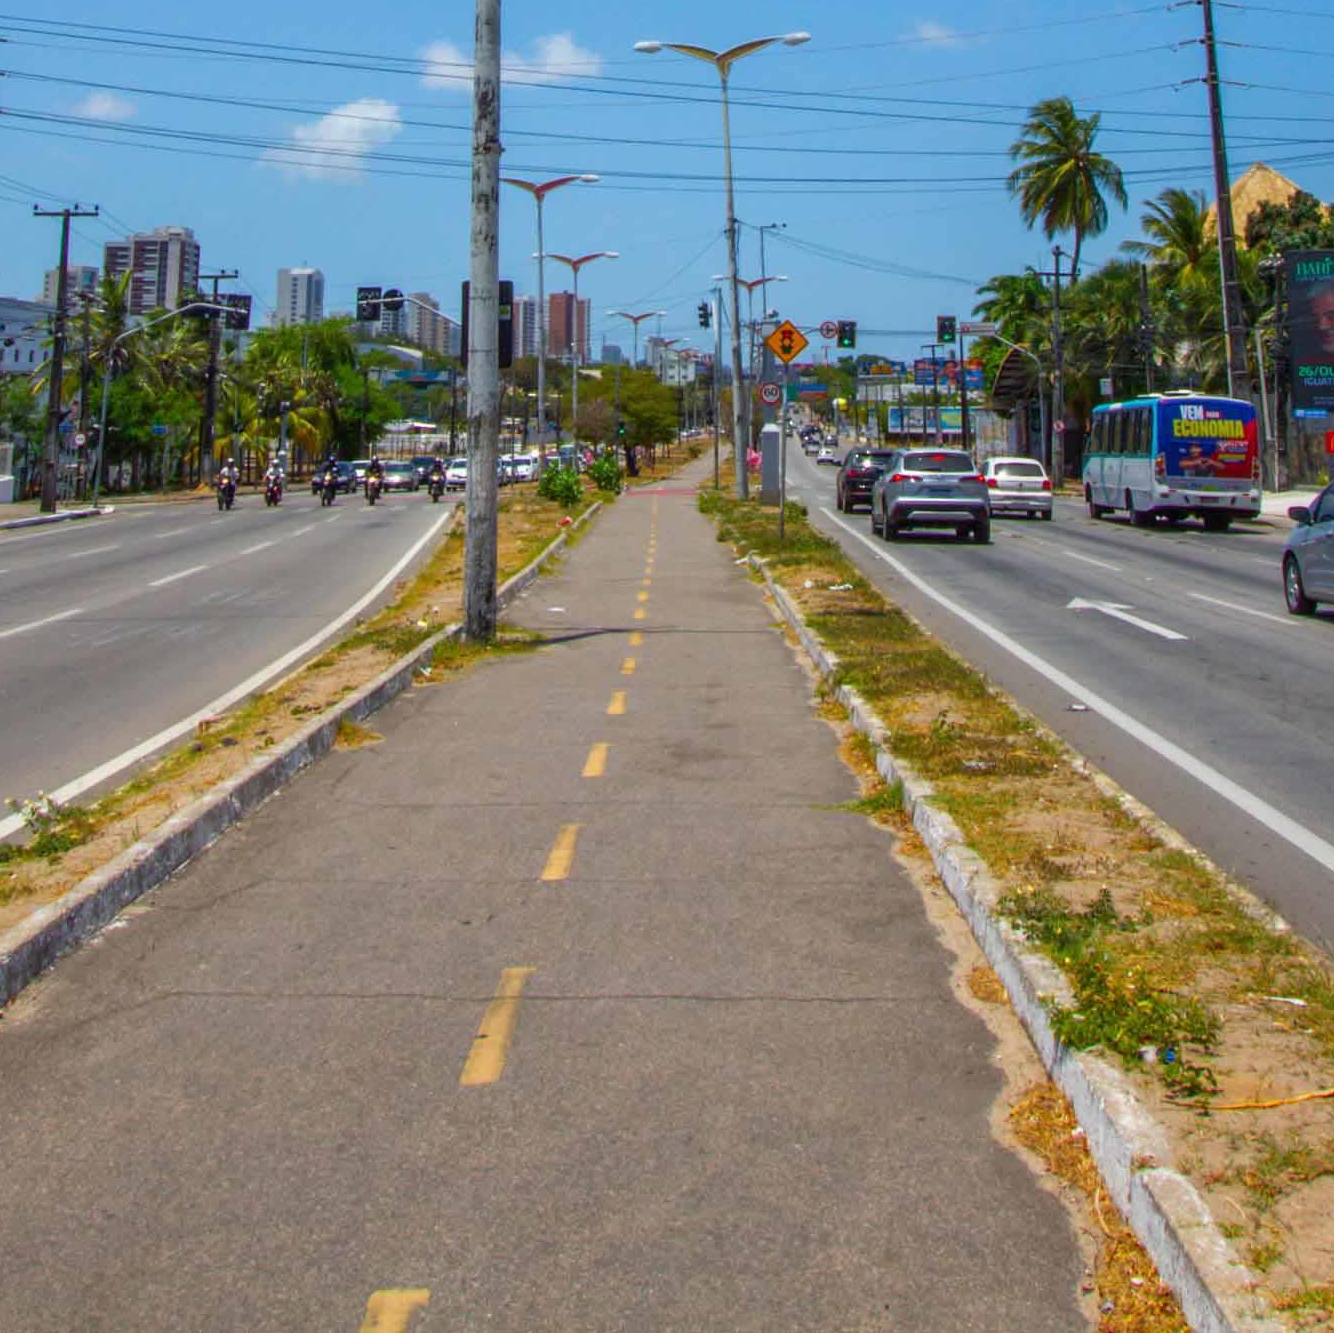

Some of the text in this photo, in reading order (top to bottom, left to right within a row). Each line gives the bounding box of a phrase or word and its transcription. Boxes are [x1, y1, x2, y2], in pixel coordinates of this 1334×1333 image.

[763, 387, 778, 397] 60
[1179, 405, 1204, 419] VEM
[1173, 418, 1245, 438] ECONOMIA
